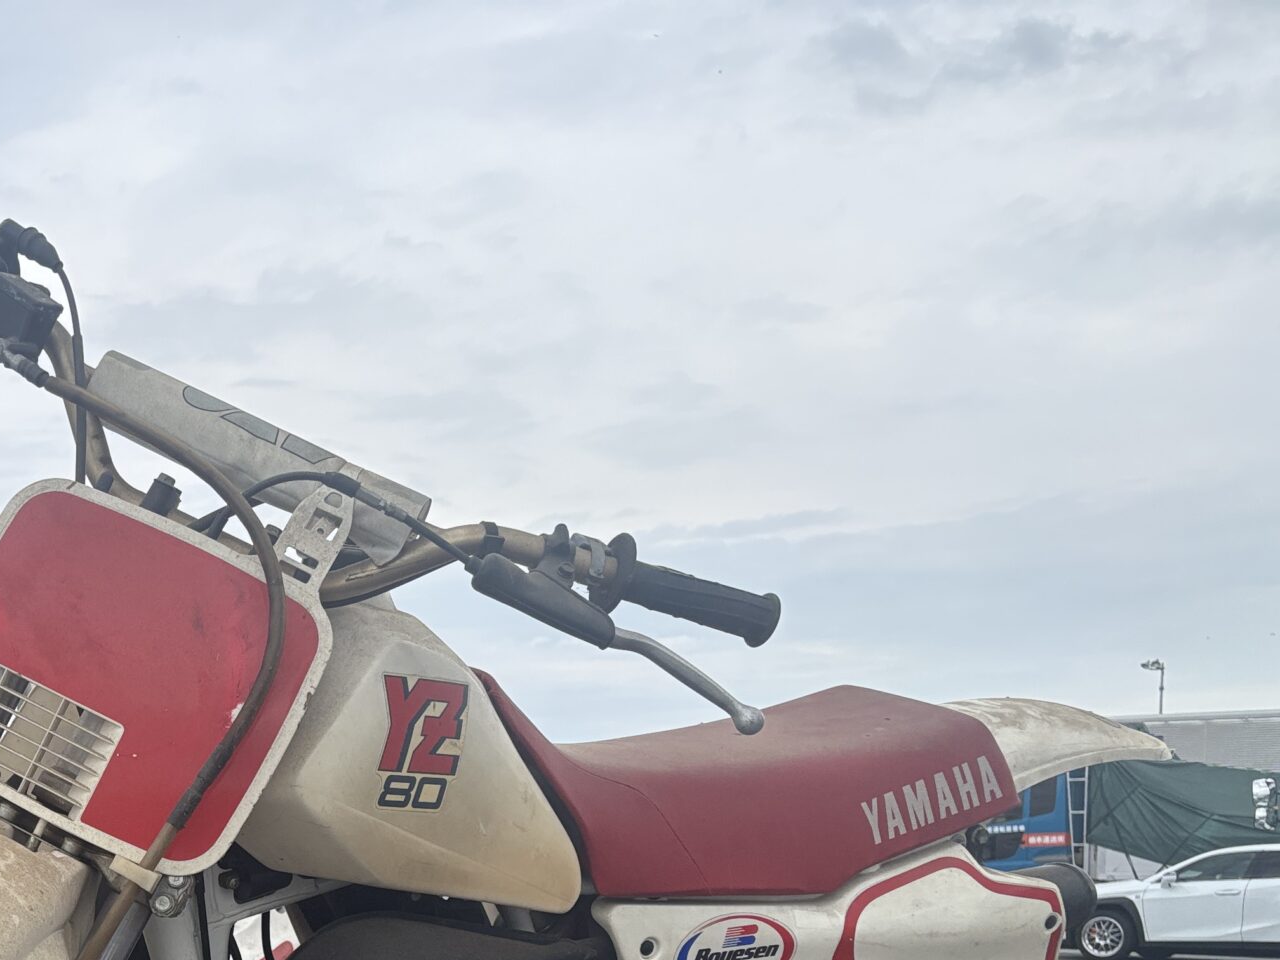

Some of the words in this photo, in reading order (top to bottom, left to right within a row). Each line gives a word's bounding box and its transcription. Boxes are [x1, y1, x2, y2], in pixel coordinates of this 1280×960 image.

[377, 674, 469, 776] YZ
[377, 775, 448, 810] 80
[861, 755, 1004, 845] YAMAHA
